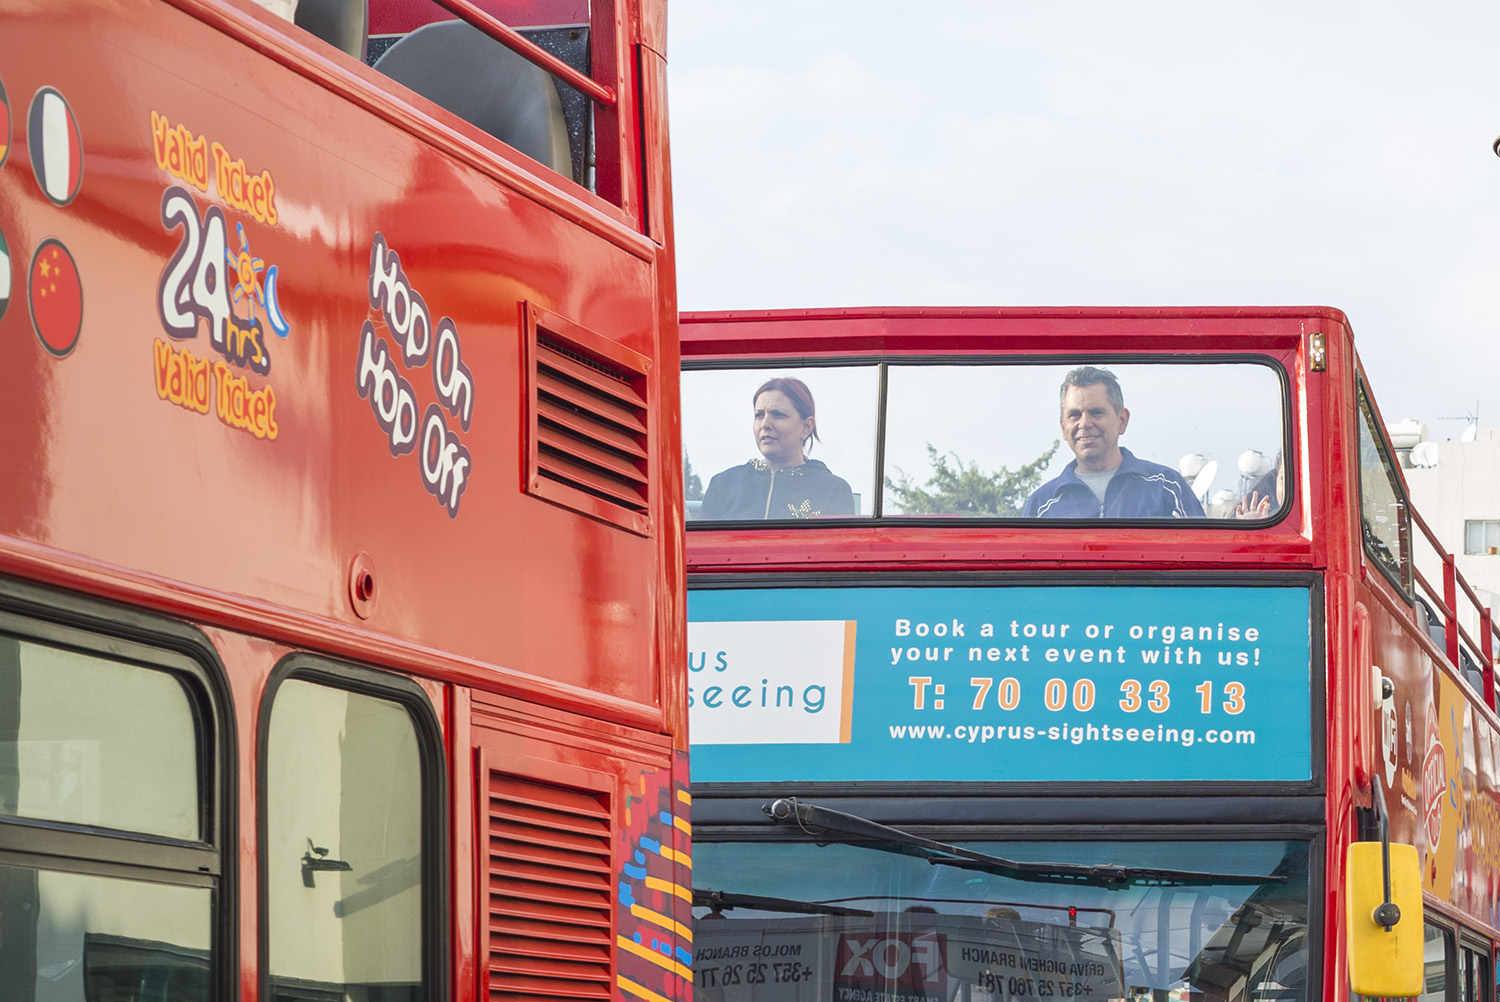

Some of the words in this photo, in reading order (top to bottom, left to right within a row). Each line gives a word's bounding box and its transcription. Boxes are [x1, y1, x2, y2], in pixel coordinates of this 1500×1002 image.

[152, 111, 209, 193] Valid
[212, 142, 277, 225] Ticket
[160, 190, 233, 347] 24
[154, 338, 210, 414] Valid
[214, 362, 277, 439] Ticket
[435, 323, 472, 427] On
[421, 409, 468, 513] Off
[891, 645, 953, 665] your
[969, 644, 1030, 661] next
[1045, 646, 1126, 664] event
[1142, 647, 1201, 665] with
[1218, 648, 1260, 666] us!
[895, 619, 965, 637] Book
[980, 624, 993, 637] a
[1010, 620, 1070, 638] tour
[1085, 624, 1114, 638] or
[1129, 622, 1260, 643] organise
[889, 723, 1256, 746] www.cyprus-sightseeing.com
[909, 676, 945, 710] T:
[970, 677, 1021, 710] 70
[1044, 678, 1096, 711] 00
[1119, 679, 1171, 713] 33
[1195, 681, 1246, 714] 13
